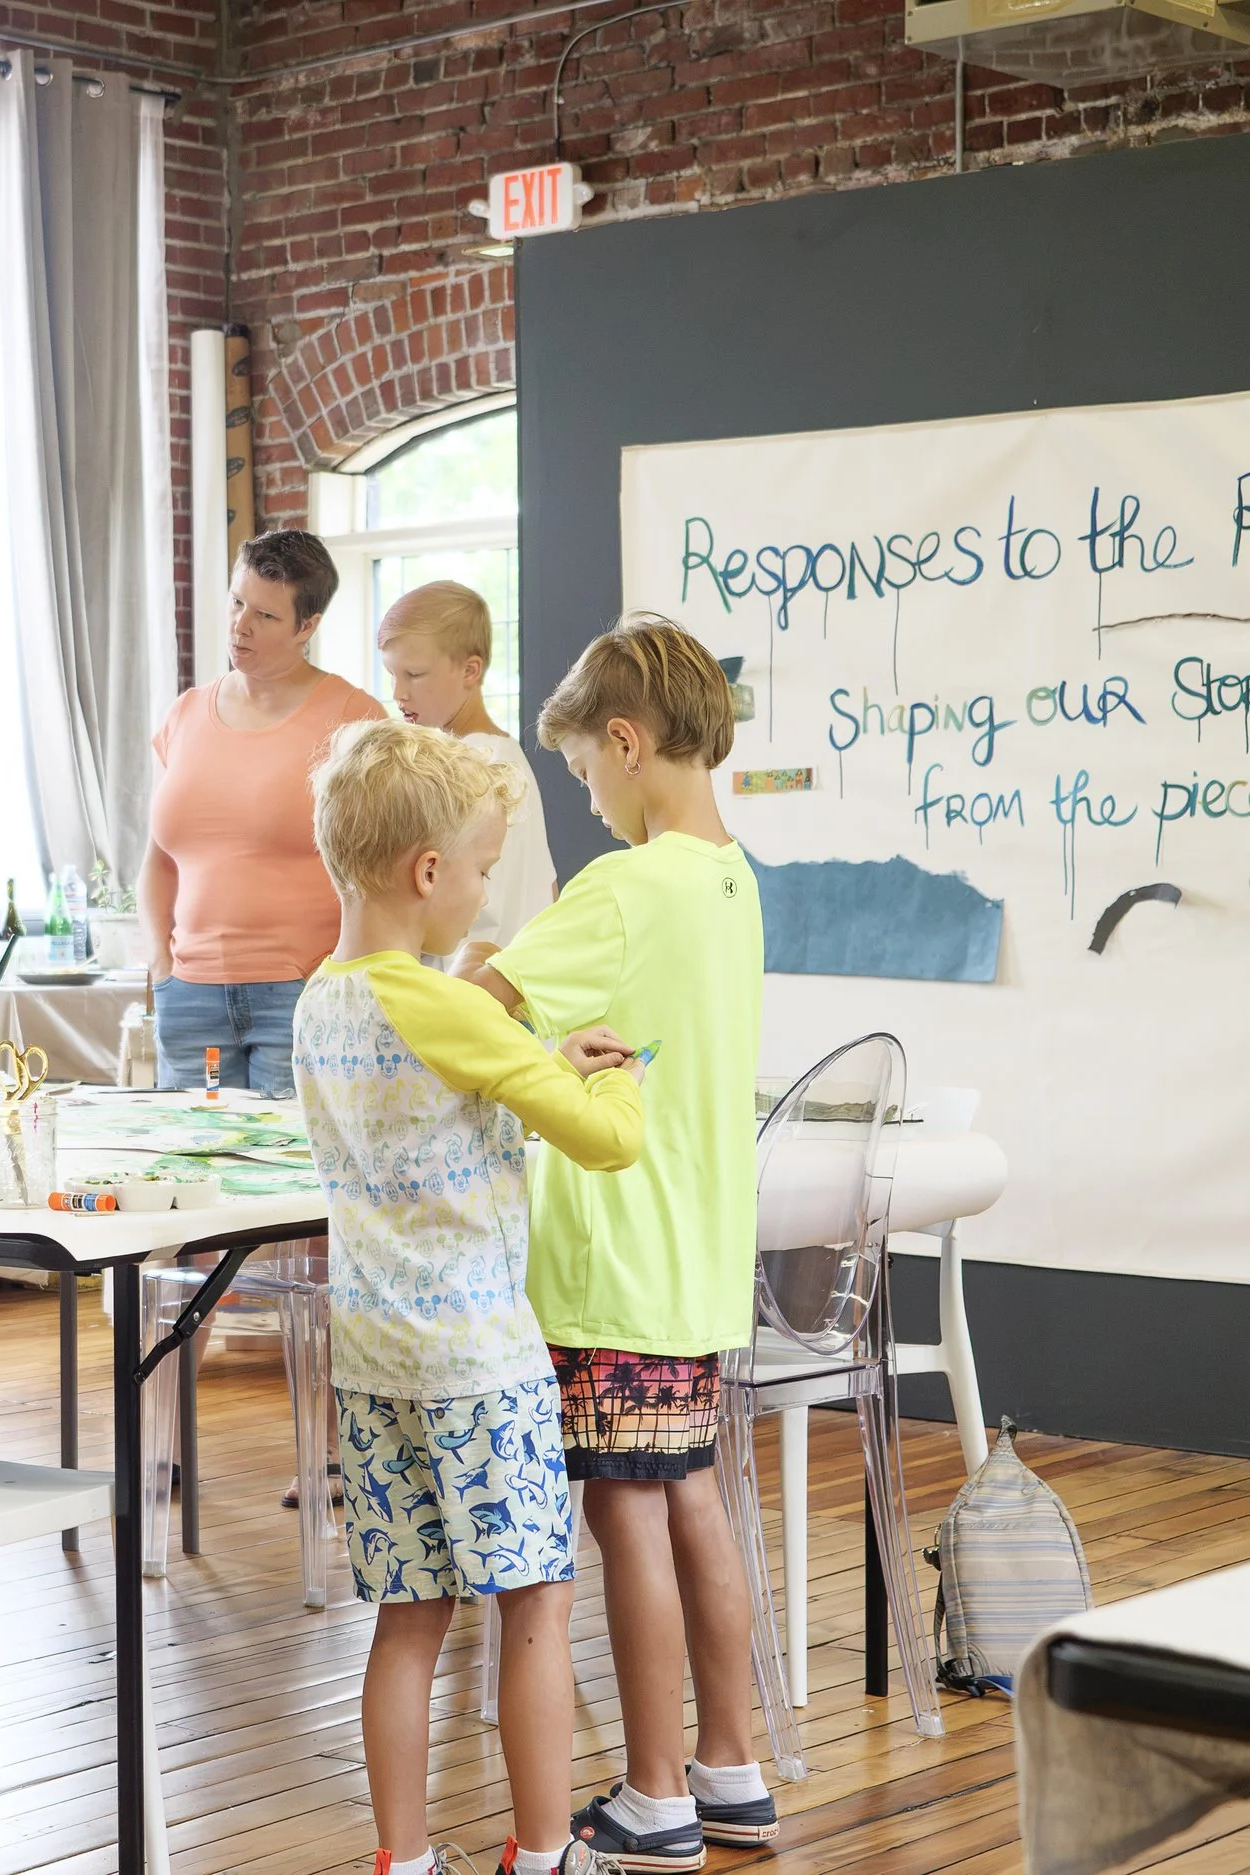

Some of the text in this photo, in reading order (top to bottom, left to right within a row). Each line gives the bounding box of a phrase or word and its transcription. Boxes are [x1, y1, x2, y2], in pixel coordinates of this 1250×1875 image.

[504, 167, 562, 231] EXIT
[999, 496, 1061, 580] to
[1079, 486, 1193, 573] the
[1051, 771, 1137, 826] the
[1151, 770, 1250, 866] piec
